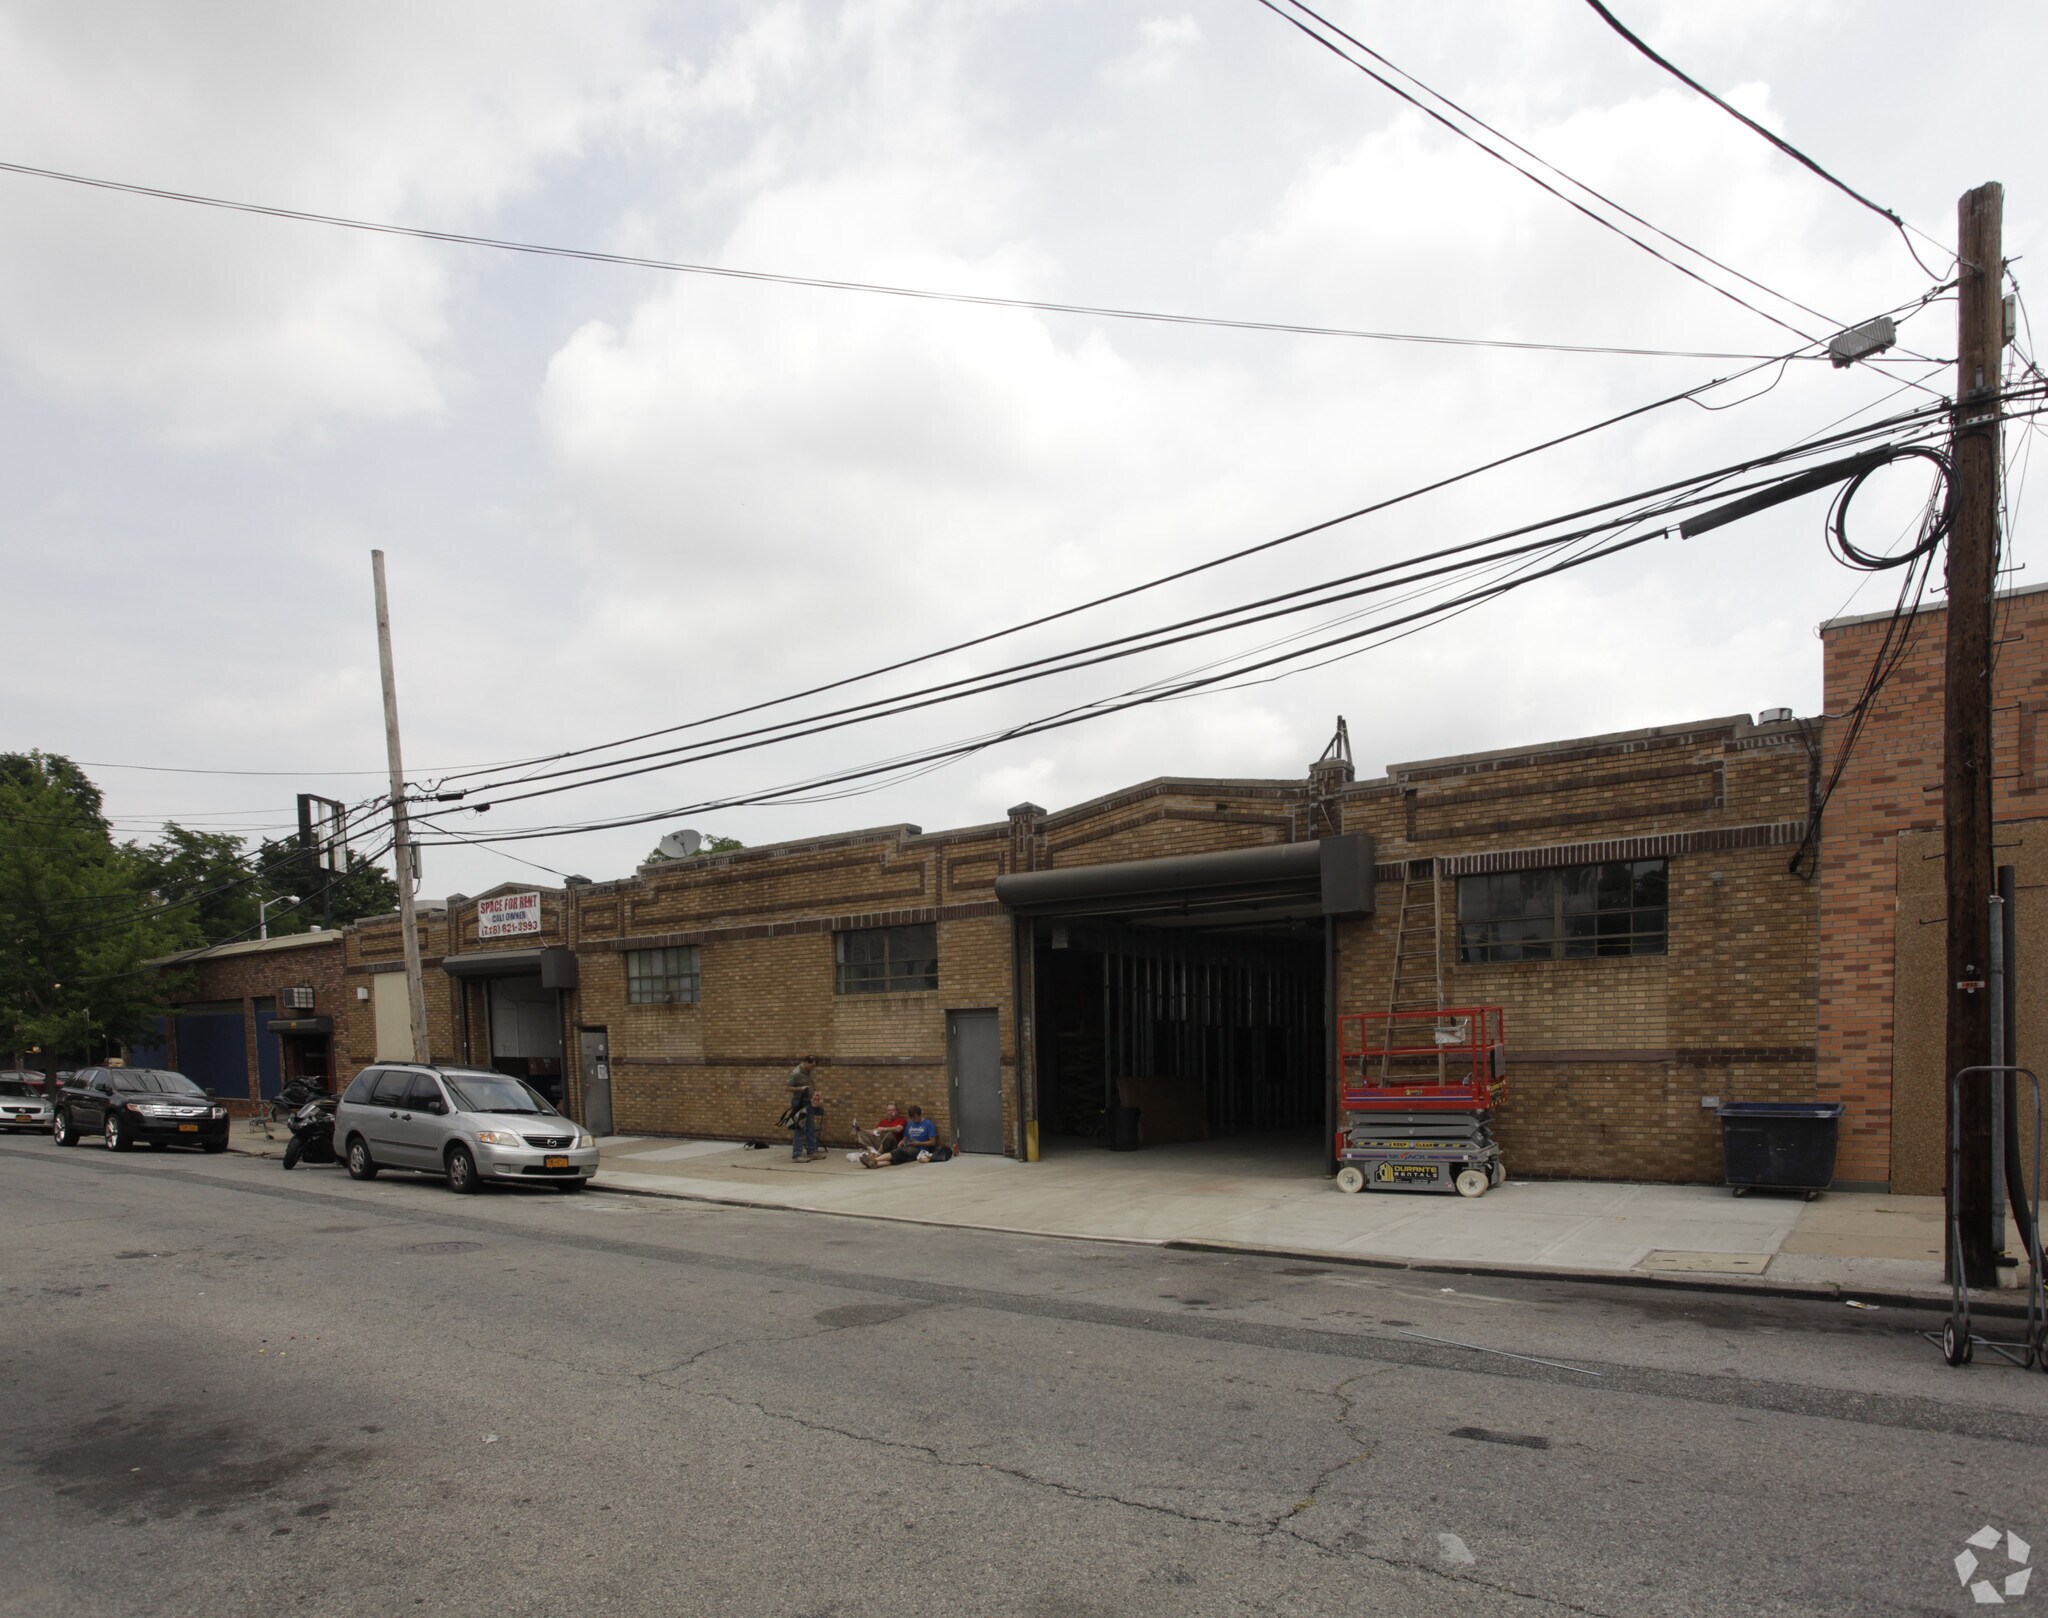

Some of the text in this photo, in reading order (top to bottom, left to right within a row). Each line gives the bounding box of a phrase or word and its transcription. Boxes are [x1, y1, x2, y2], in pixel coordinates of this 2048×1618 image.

[480, 895, 537, 914] SPACE FOR RENT
[505, 911, 526, 920] OWNER
[481, 921, 538, 936] (718) 821-3993
[1394, 1165, 1437, 1173] DURANTE
